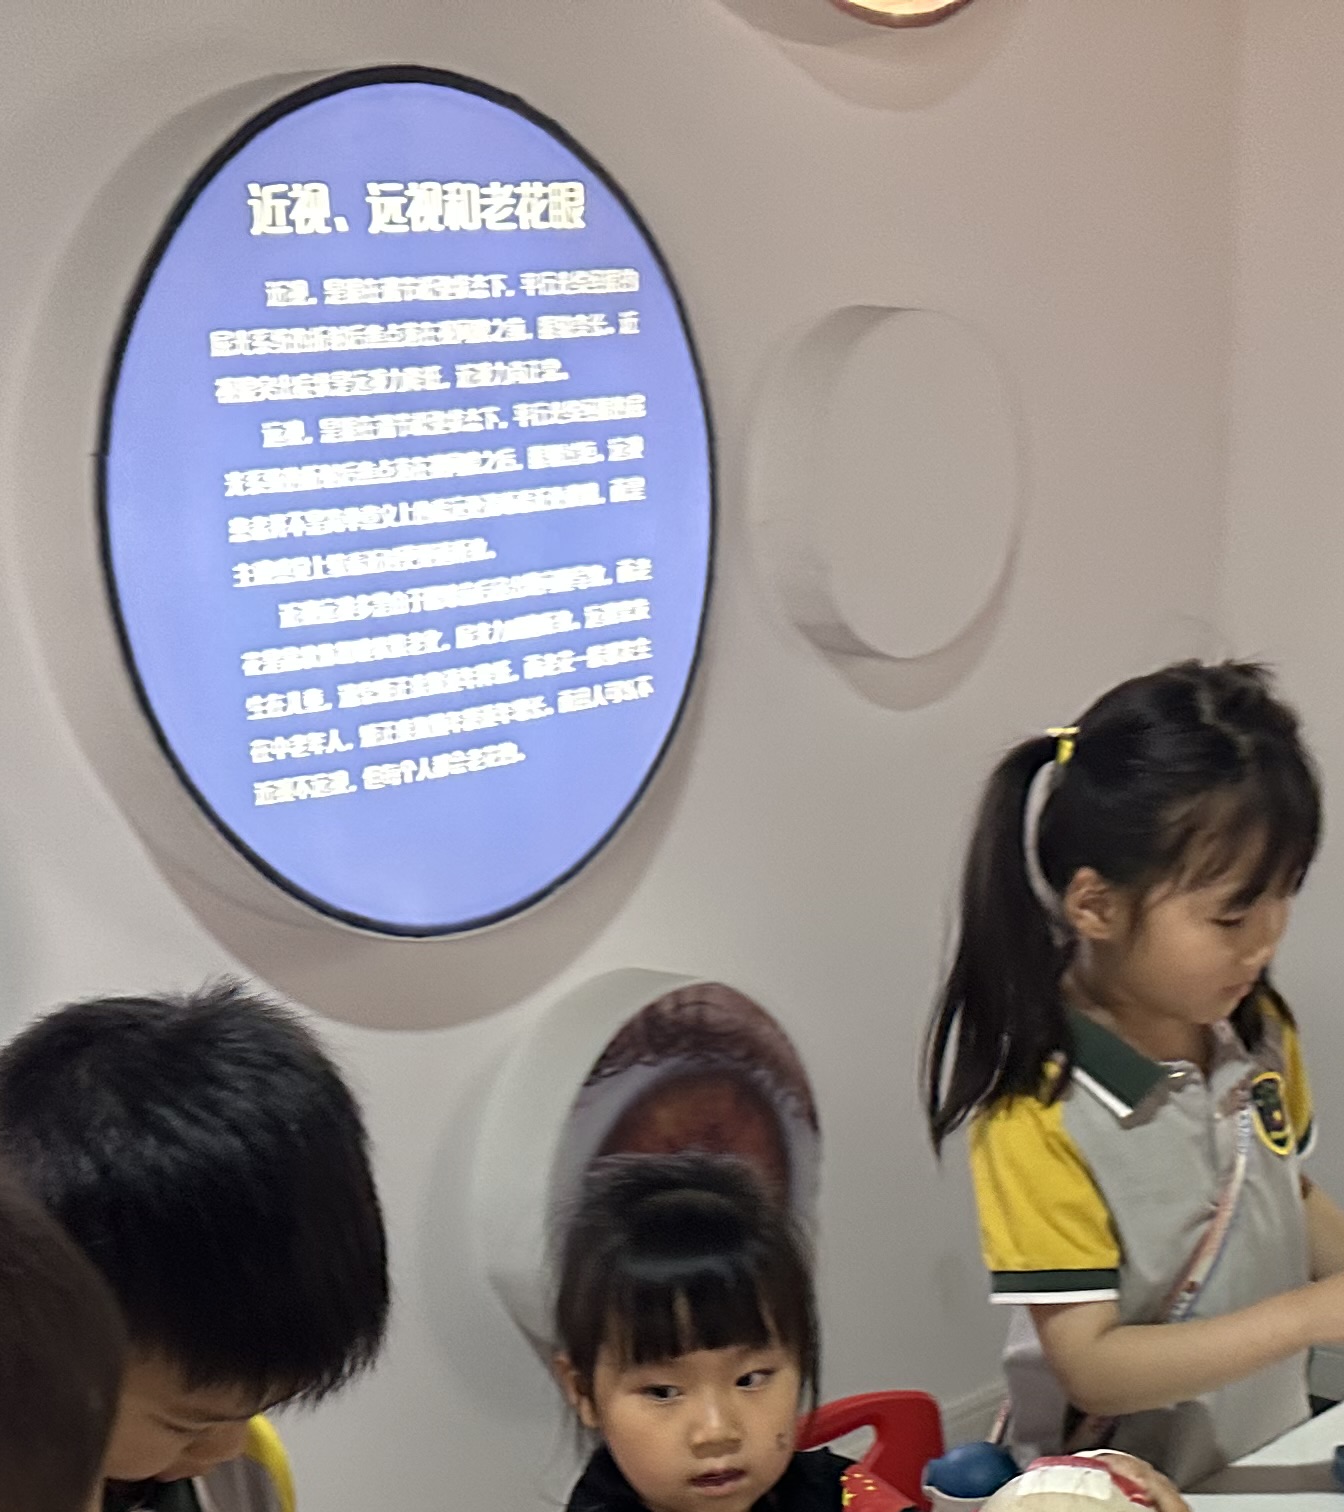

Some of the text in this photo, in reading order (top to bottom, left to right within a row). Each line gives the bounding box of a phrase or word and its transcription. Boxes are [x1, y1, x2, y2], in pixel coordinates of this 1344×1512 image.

[247, 180, 586, 235] 近视、远视和老花眼
